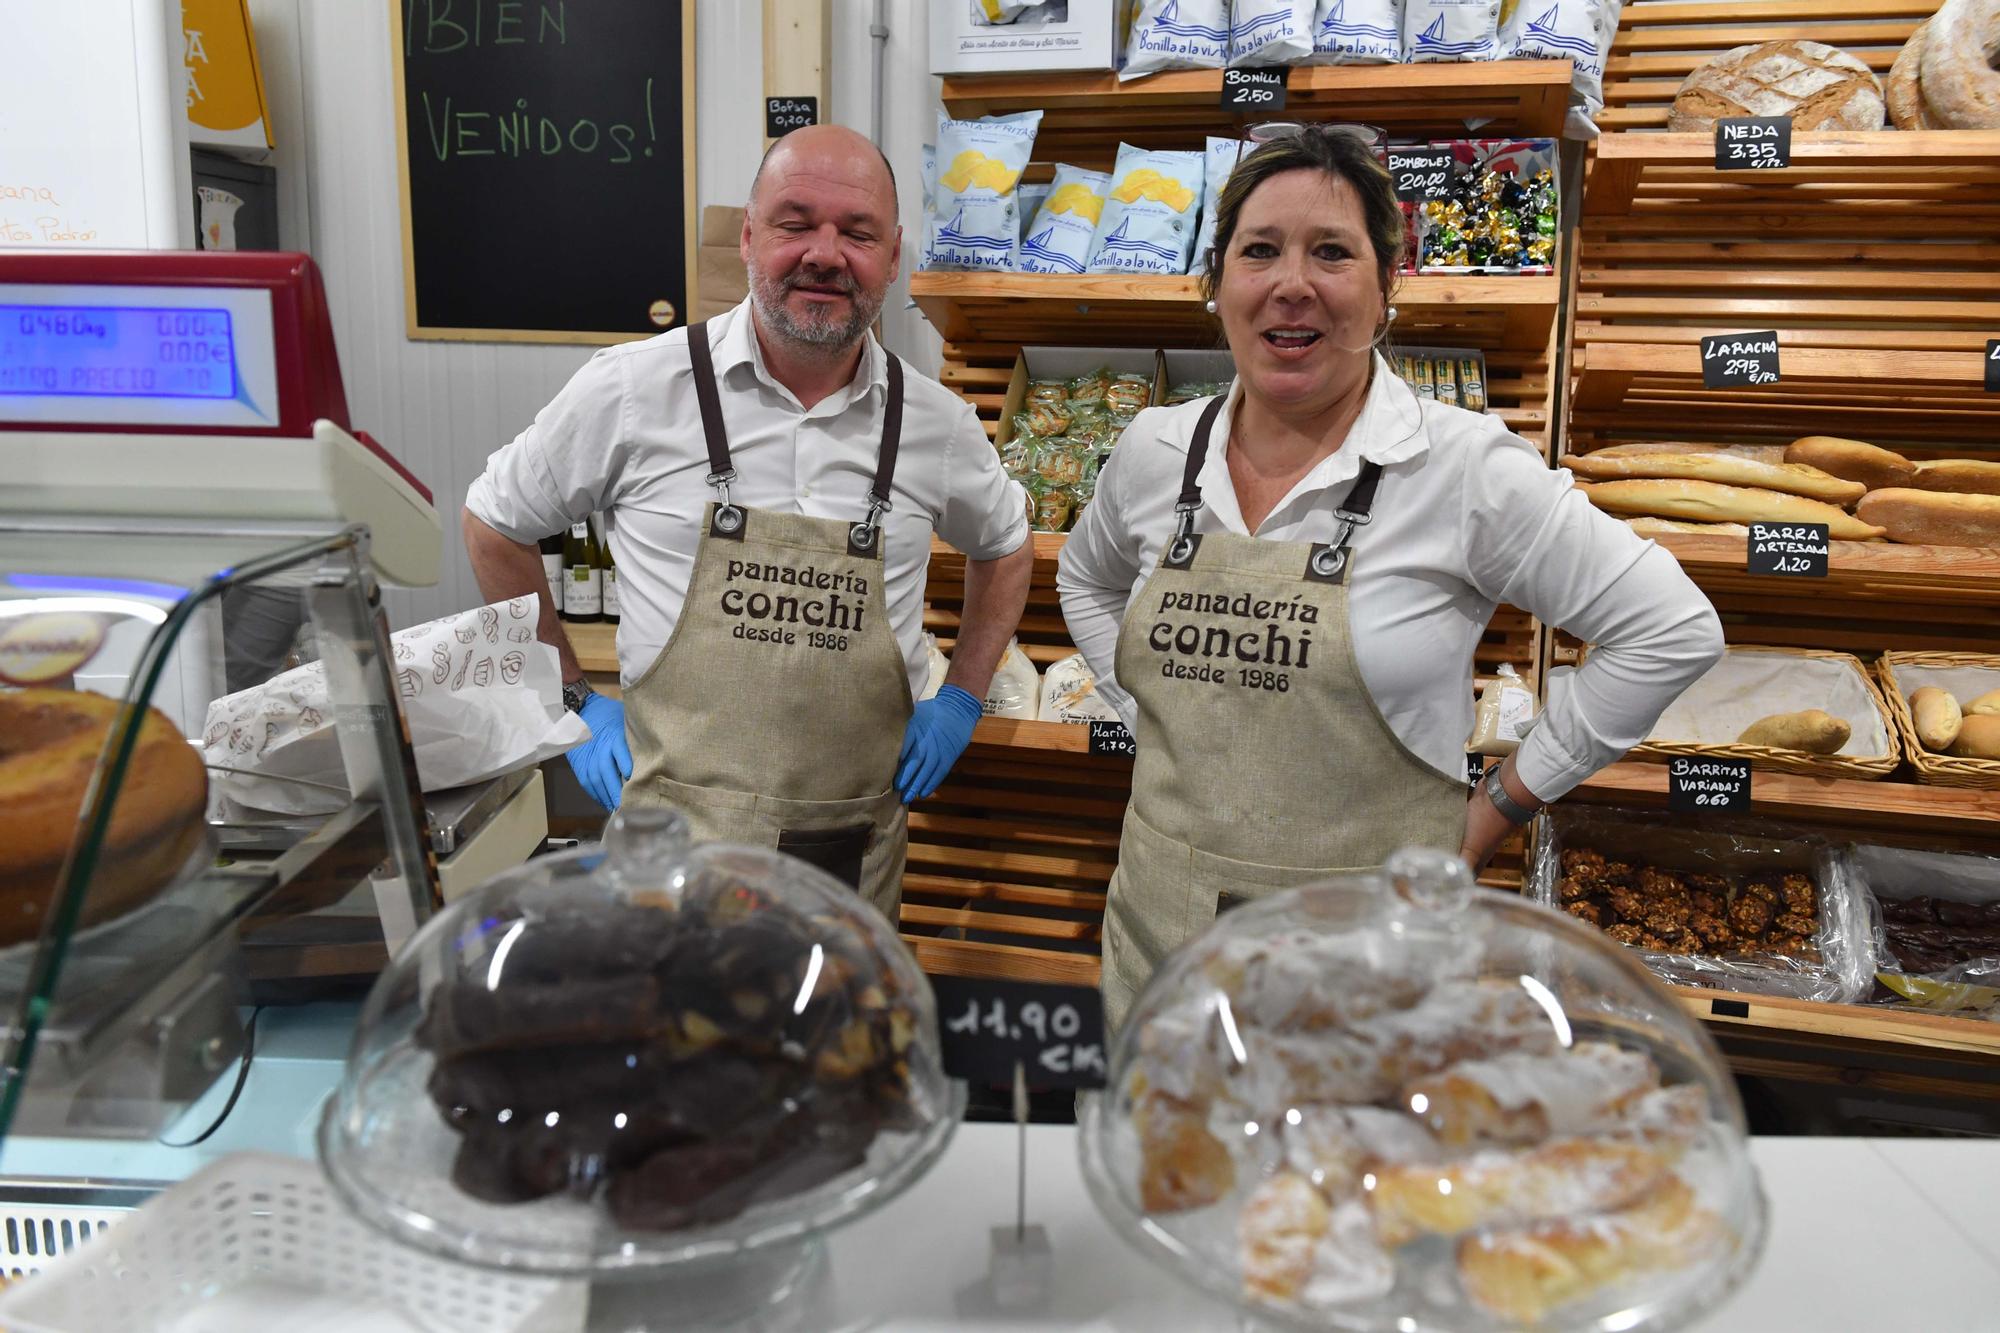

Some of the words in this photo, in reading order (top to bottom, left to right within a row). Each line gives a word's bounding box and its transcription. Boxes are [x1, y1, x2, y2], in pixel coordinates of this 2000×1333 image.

[1139, 28, 1177, 53] Bonilla
[1179, 43, 1187, 53] a
[1188, 39, 1199, 55] la
[1264, 22, 1294, 43] vista
[1346, 43, 1353, 53] a
[1355, 37, 1366, 54] la
[1369, 42, 1399, 58] vista
[1573, 57, 1601, 76] vista
[1225, 70, 1281, 85] BONILLA
[1724, 125, 1779, 140] NEDA
[963, 253, 970, 264] a
[972, 249, 982, 265] la
[1125, 257, 1132, 267] a
[1134, 252, 1145, 268] la
[1704, 340, 1777, 360] LARACHA
[1753, 524, 1820, 541] BARRA
[1755, 541, 1829, 555] ARTESANA
[726, 560, 869, 595] panadería
[721, 589, 865, 632] conchi
[1157, 591, 1320, 624] panadería
[733, 623, 796, 646] desde
[807, 631, 848, 652] 1986
[1149, 622, 1313, 669] conchi
[1161, 659, 1226, 684] desde
[1239, 668, 1290, 693] 1986
[1092, 722, 1131, 738] Harin
[1670, 758, 1748, 779] BARRITAS
[1679, 778, 1741, 793] VARIADAS
